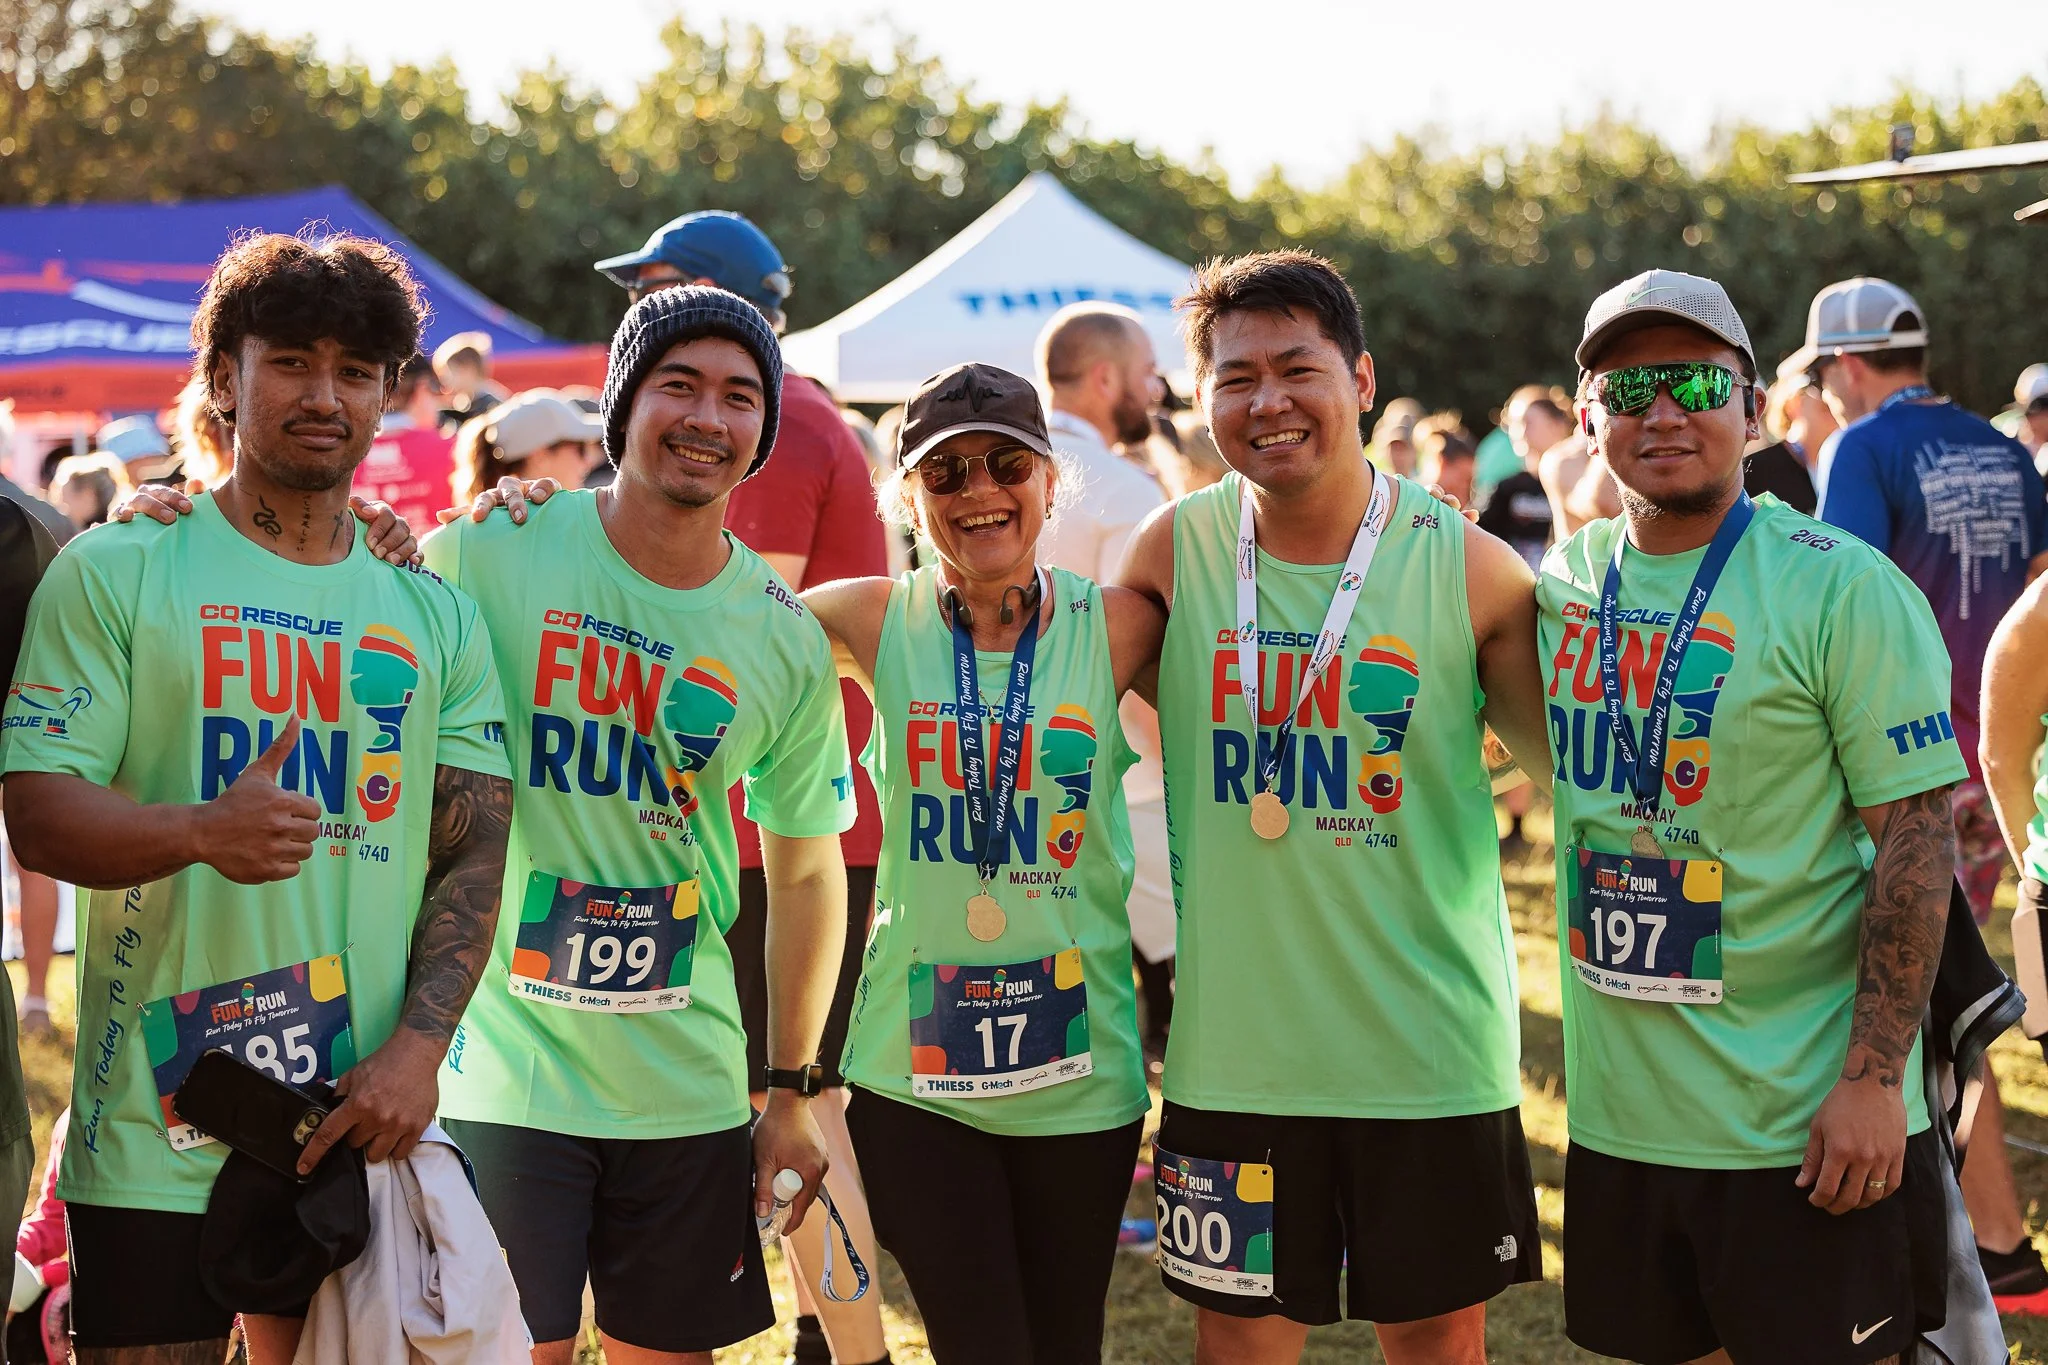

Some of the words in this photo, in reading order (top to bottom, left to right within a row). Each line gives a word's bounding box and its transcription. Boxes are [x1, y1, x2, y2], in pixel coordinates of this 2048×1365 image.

[1789, 529, 1841, 551] 2025
[765, 579, 803, 618] 2025
[1690, 586, 1707, 615] Run
[200, 604, 343, 635] CQRESCUE
[1561, 602, 1676, 626] CQRSCUE
[1603, 594, 1614, 649] Tomorrow
[543, 609, 675, 661] CQRESCUE
[1671, 619, 1694, 653] Today
[202, 626, 341, 722] FUN
[1017, 661, 1029, 687] Run
[1602, 653, 1616, 674] Fly
[1667, 658, 1679, 672] To
[533, 629, 666, 737] FUN
[960, 653, 975, 707] Tomorrow
[1211, 649, 1342, 729] FUN
[1605, 680, 1616, 694] To
[1657, 676, 1673, 699] Fly
[1006, 691, 1026, 723] Today
[1608, 698, 1622, 733] Today
[961, 711, 979, 732] Fly
[1007, 728, 1020, 742] To
[964, 737, 979, 751] To
[1649, 705, 1666, 767] Tomorrow
[529, 712, 670, 807] RUN
[1000, 746, 1018, 769] Fly
[1619, 739, 1635, 763] Run
[965, 756, 983, 791] Today
[1212, 729, 1348, 810] RUN
[972, 797, 985, 823] Run
[996, 774, 1013, 832] Tomorrow
[650, 830, 667, 841] QLD
[1316, 817, 1375, 832] MACKAY
[1664, 826, 1699, 845] 4740
[329, 845, 347, 857] QLD
[359, 844, 389, 862] 4740
[1335, 837, 1352, 847] QLD
[1365, 834, 1398, 848] 4740
[1009, 871, 1061, 885] MACKAY
[1596, 872, 1617, 889] FUN
[1630, 876, 1657, 893] RUN
[1026, 889, 1041, 899] QLD
[585, 902, 614, 918] FUN
[626, 904, 654, 919] RUN
[113, 926, 142, 969] Fly
[1590, 907, 1667, 969] 197
[566, 932, 656, 986] 199
[1578, 964, 1601, 985] THIESS
[109, 979, 126, 1006] To
[524, 982, 572, 1002] THIESS
[965, 984, 991, 998] FUN
[1005, 979, 1033, 997] RUN
[212, 1002, 242, 1024] FUN
[256, 990, 287, 1012] RUN
[95, 1018, 125, 1086] Today
[220, 1023, 318, 1084] 85
[448, 1024, 466, 1074] Run
[975, 1013, 1027, 1068] 17
[927, 1080, 974, 1092] THIESS
[84, 1098, 104, 1153] Run
[1160, 1167, 1177, 1185] FUN
[1188, 1176, 1213, 1192] RUN
[1156, 1194, 1231, 1263] 200
